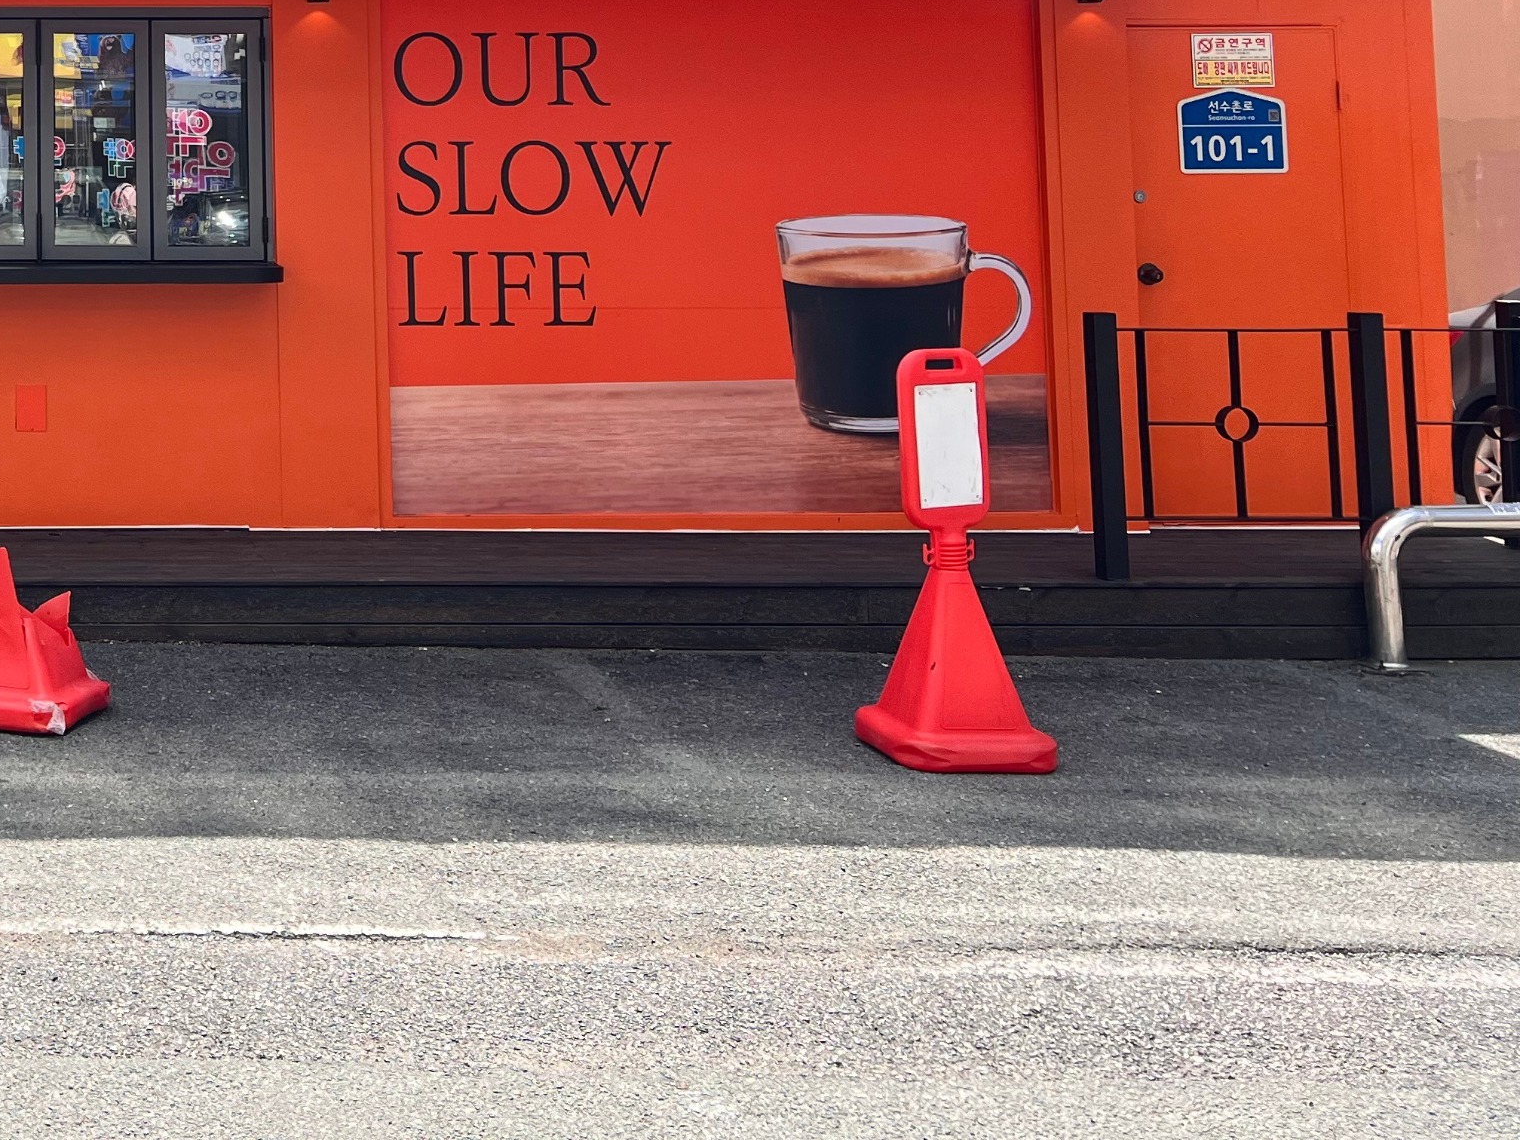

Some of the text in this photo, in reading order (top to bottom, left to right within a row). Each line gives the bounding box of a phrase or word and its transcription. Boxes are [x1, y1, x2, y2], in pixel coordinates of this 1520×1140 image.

[392, 30, 610, 107] OUR
[1215, 37, 1266, 48] 금연구역
[1208, 100, 1254, 113] 선수촌로
[1190, 135, 1274, 162] 101-1
[395, 140, 672, 218] SLOW
[397, 250, 597, 327] LIFE
